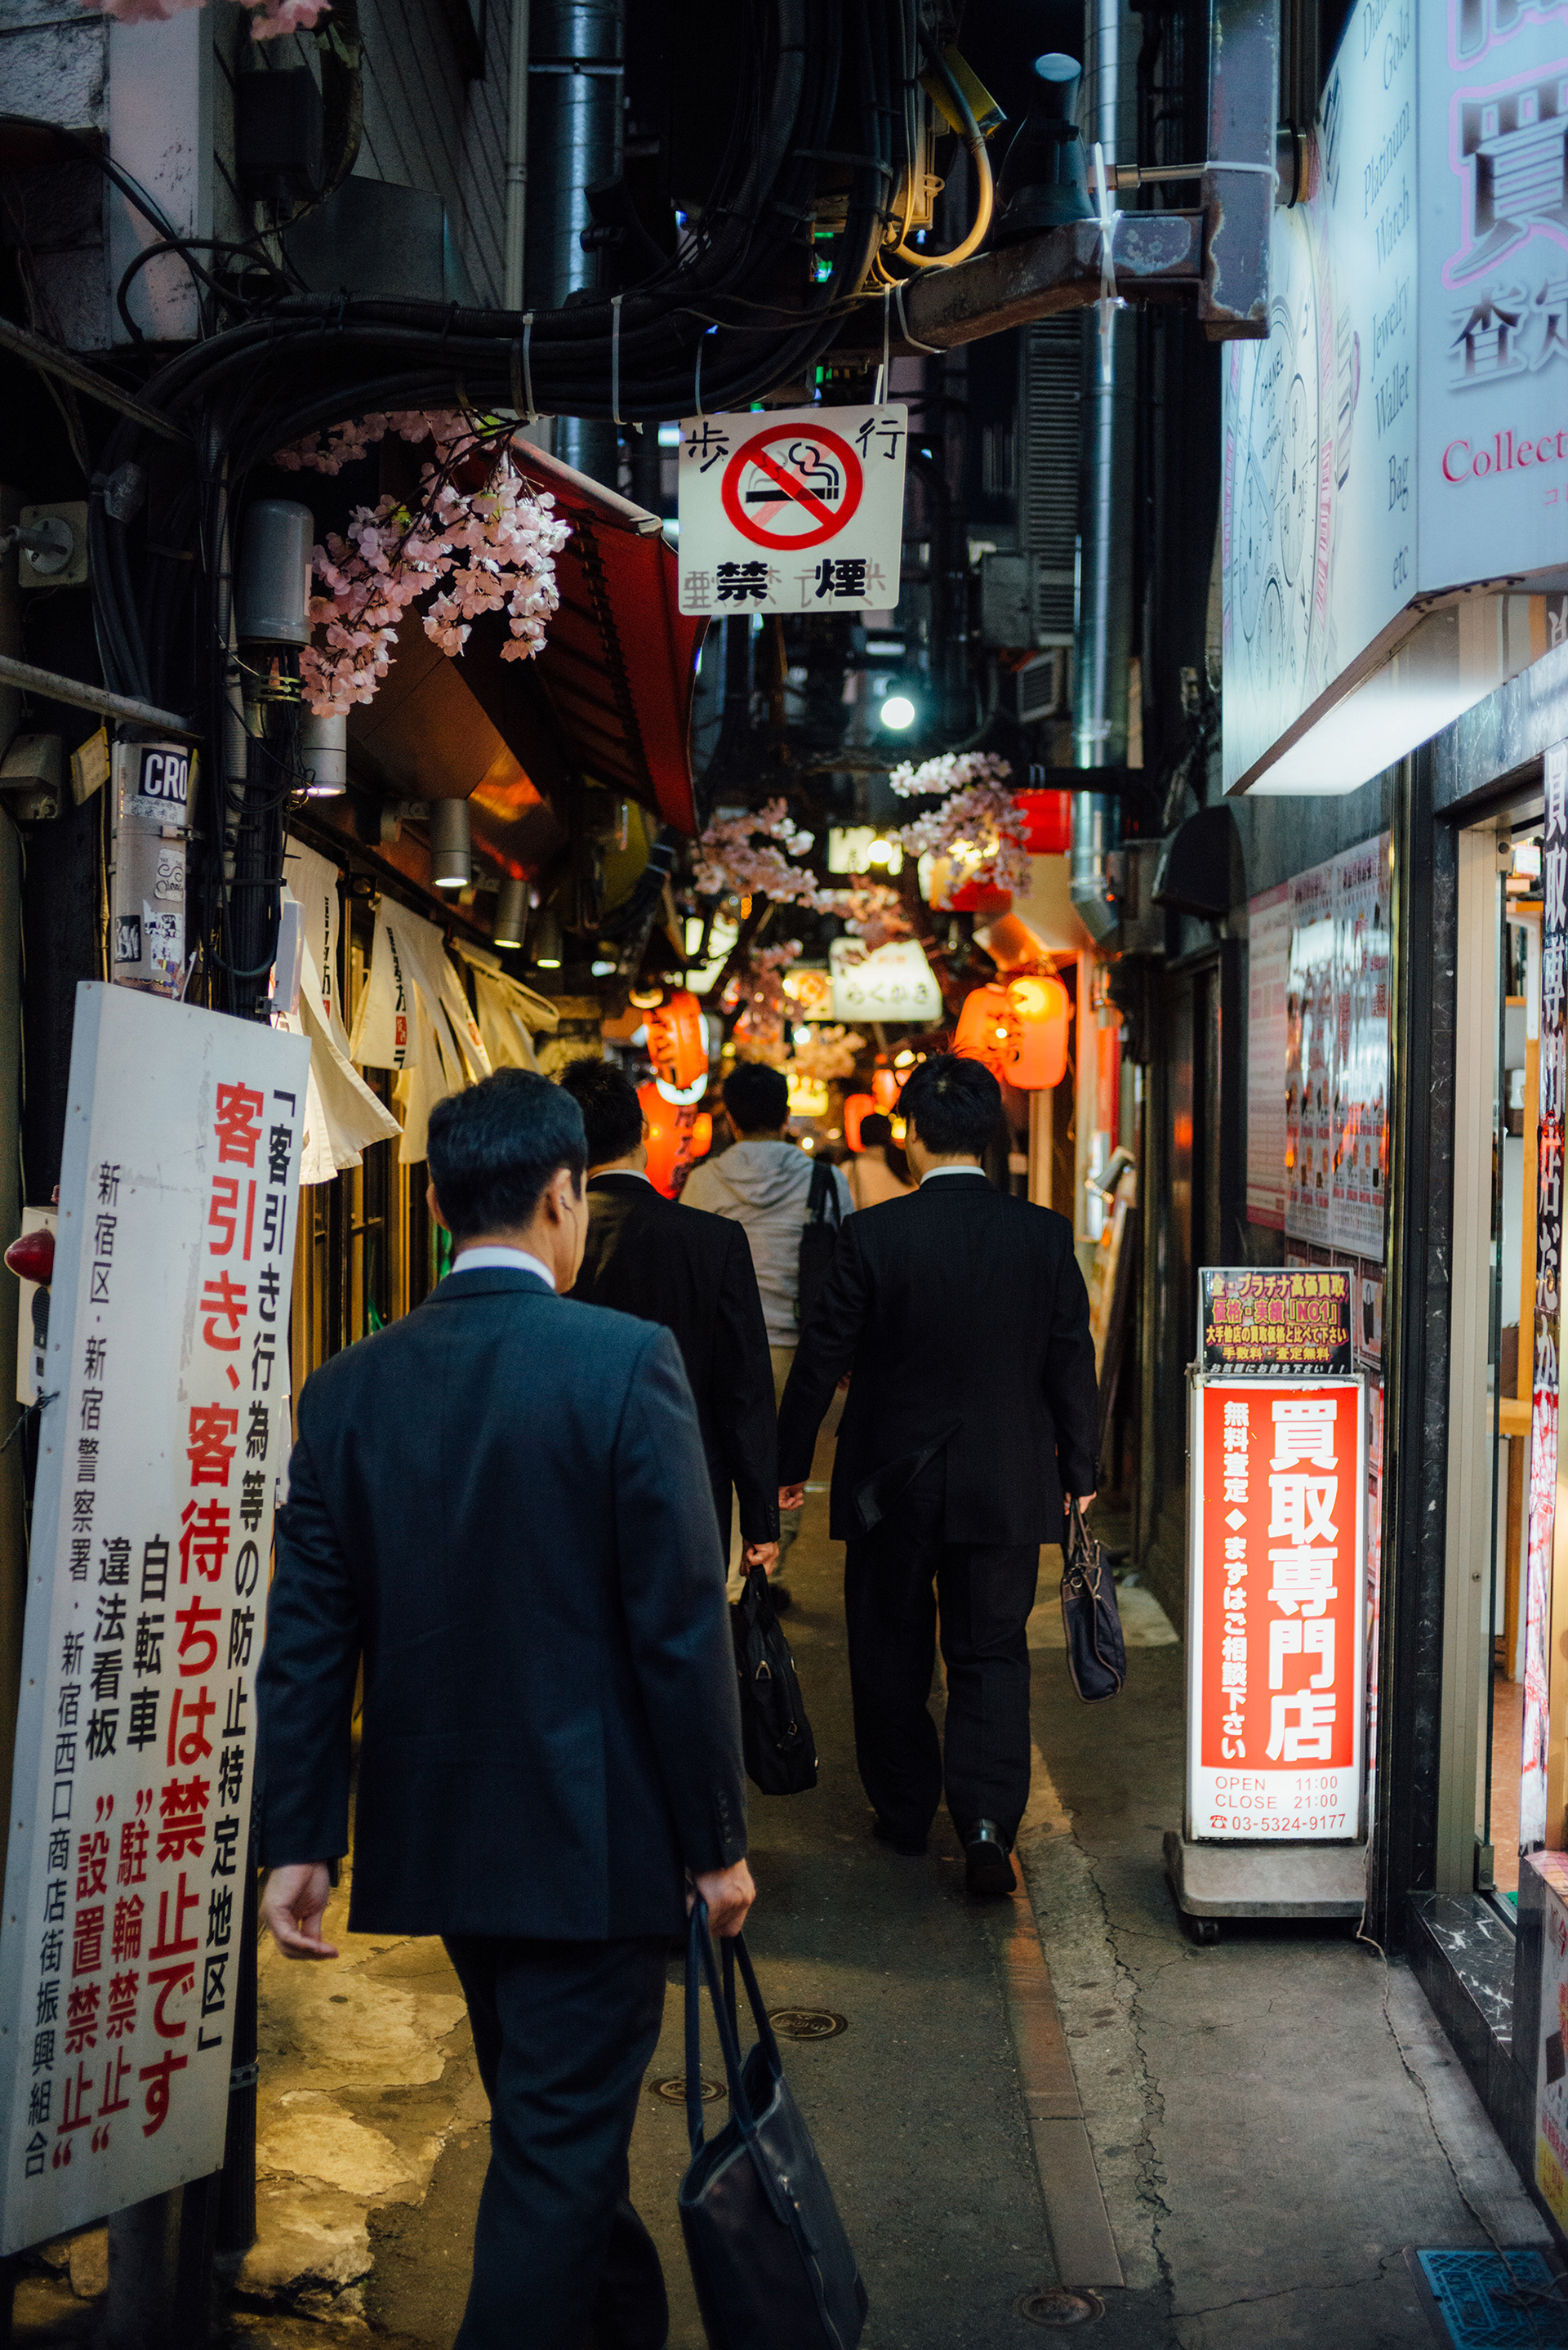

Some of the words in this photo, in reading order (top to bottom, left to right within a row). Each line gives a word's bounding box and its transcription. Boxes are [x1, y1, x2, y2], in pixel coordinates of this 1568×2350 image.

[1364, 101, 1410, 219] Platinum
[1376, 175, 1410, 273] Watch
[1371, 275, 1410, 383] Jewelry
[1374, 360, 1410, 442] Wallet
[1388, 453, 1410, 513] Bag
[717, 558, 866, 600] 禁煙
[1392, 544, 1410, 591] etc
[1211, 1273, 1347, 1298] 金・プラチナ高価買取
[1205, 1325, 1347, 1344] 大手他店の買取価格と比べて下さい
[1222, 1346, 1331, 1362] 手数料・査定無料
[138, 1081, 265, 2138] 客引き、客待ちは禁止です
[1265, 1399, 1339, 1762] 買取専門店
[85, 1536, 131, 1761] 違法看板
[127, 1533, 170, 1753] 自転車
[1221, 1536, 1249, 1759] まずはご相談下さい
[1215, 1776, 1266, 1790] OPEN
[1295, 1776, 1338, 1790] 11:00
[1215, 1794, 1277, 1809] CLOSE
[1294, 1794, 1338, 1809] 21:00
[1232, 1813, 1346, 1831] 03-5324-9177
